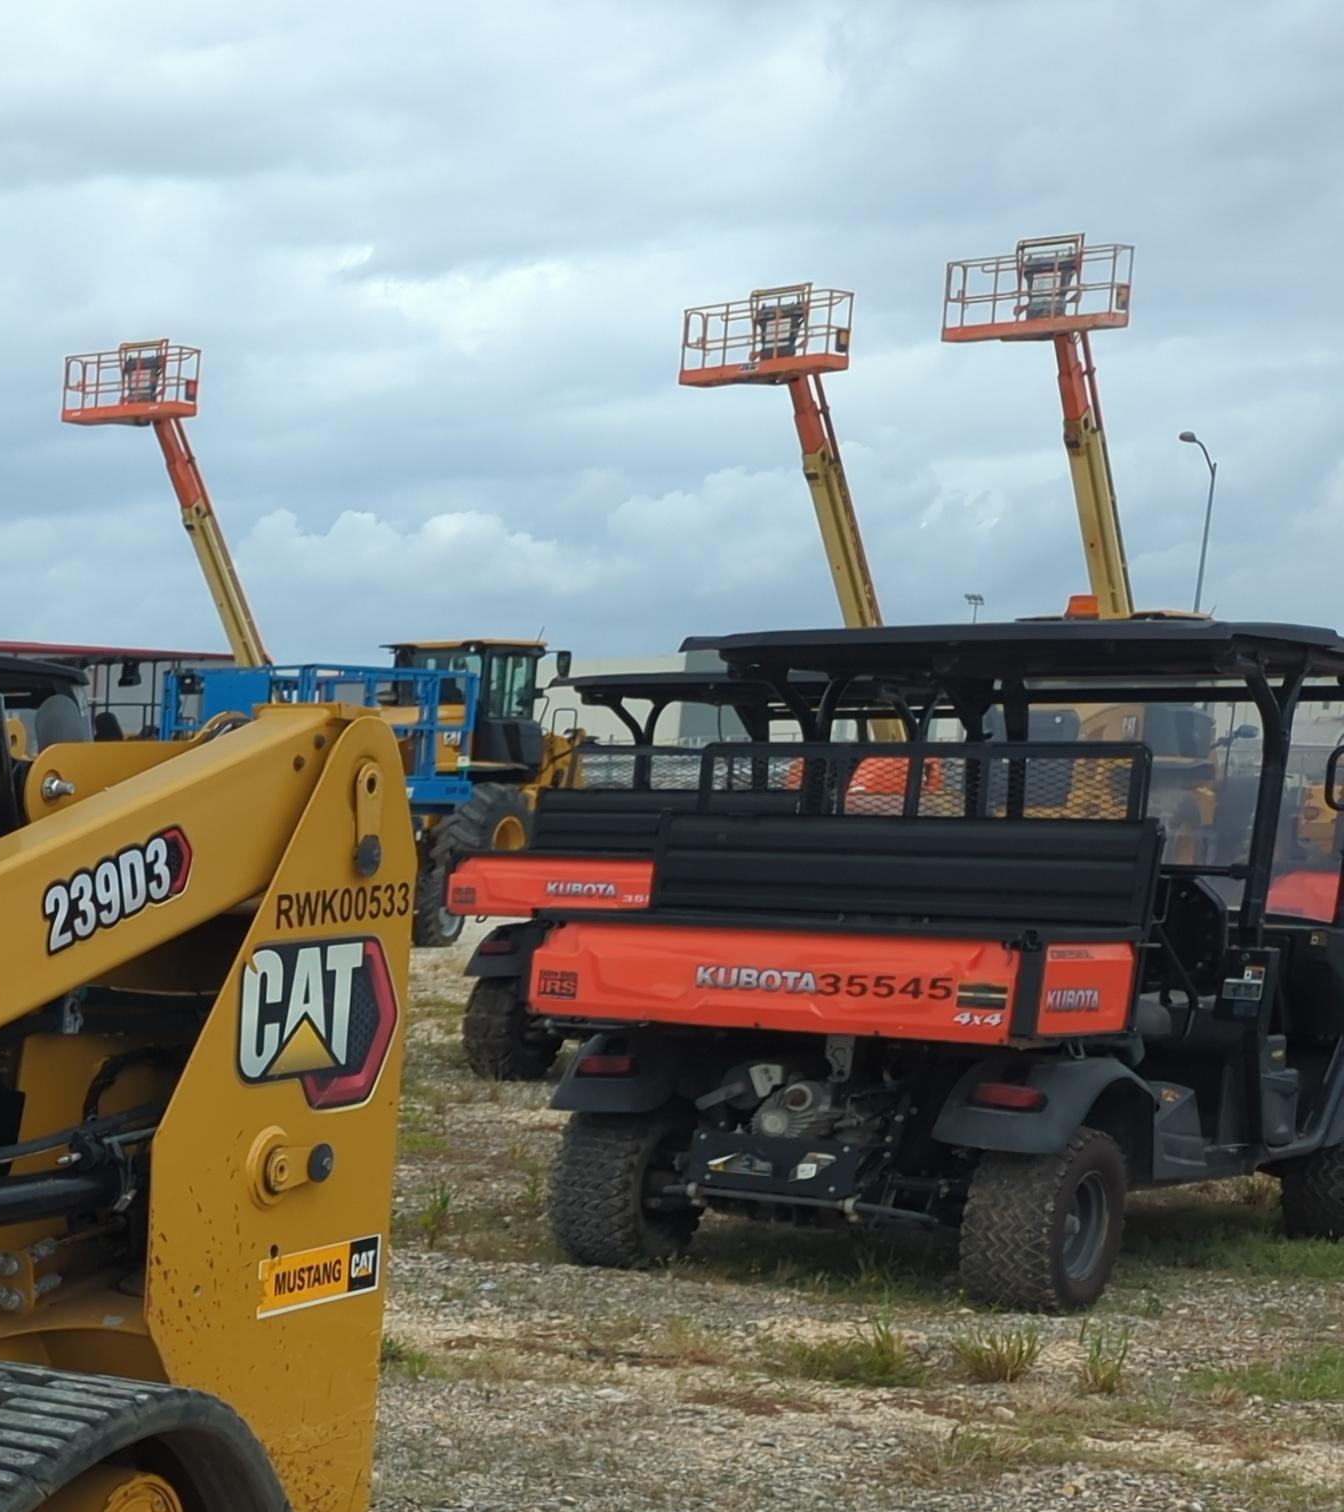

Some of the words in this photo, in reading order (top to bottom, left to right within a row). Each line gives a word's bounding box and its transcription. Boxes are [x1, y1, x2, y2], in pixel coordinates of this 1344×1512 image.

[44, 837, 171, 953] 239D3
[545, 881, 618, 897] KUBOTA
[275, 882, 410, 930] RWK00533
[540, 979, 576, 995] IRS
[696, 966, 817, 994] KUBOTA
[817, 974, 953, 1000] 35545
[239, 941, 364, 1079] CAT
[1045, 988, 1100, 1012] KUBOTA
[953, 1011, 1004, 1026] 4x4
[274, 1258, 342, 1297] MUSTANG
[351, 1249, 376, 1279] CAT
